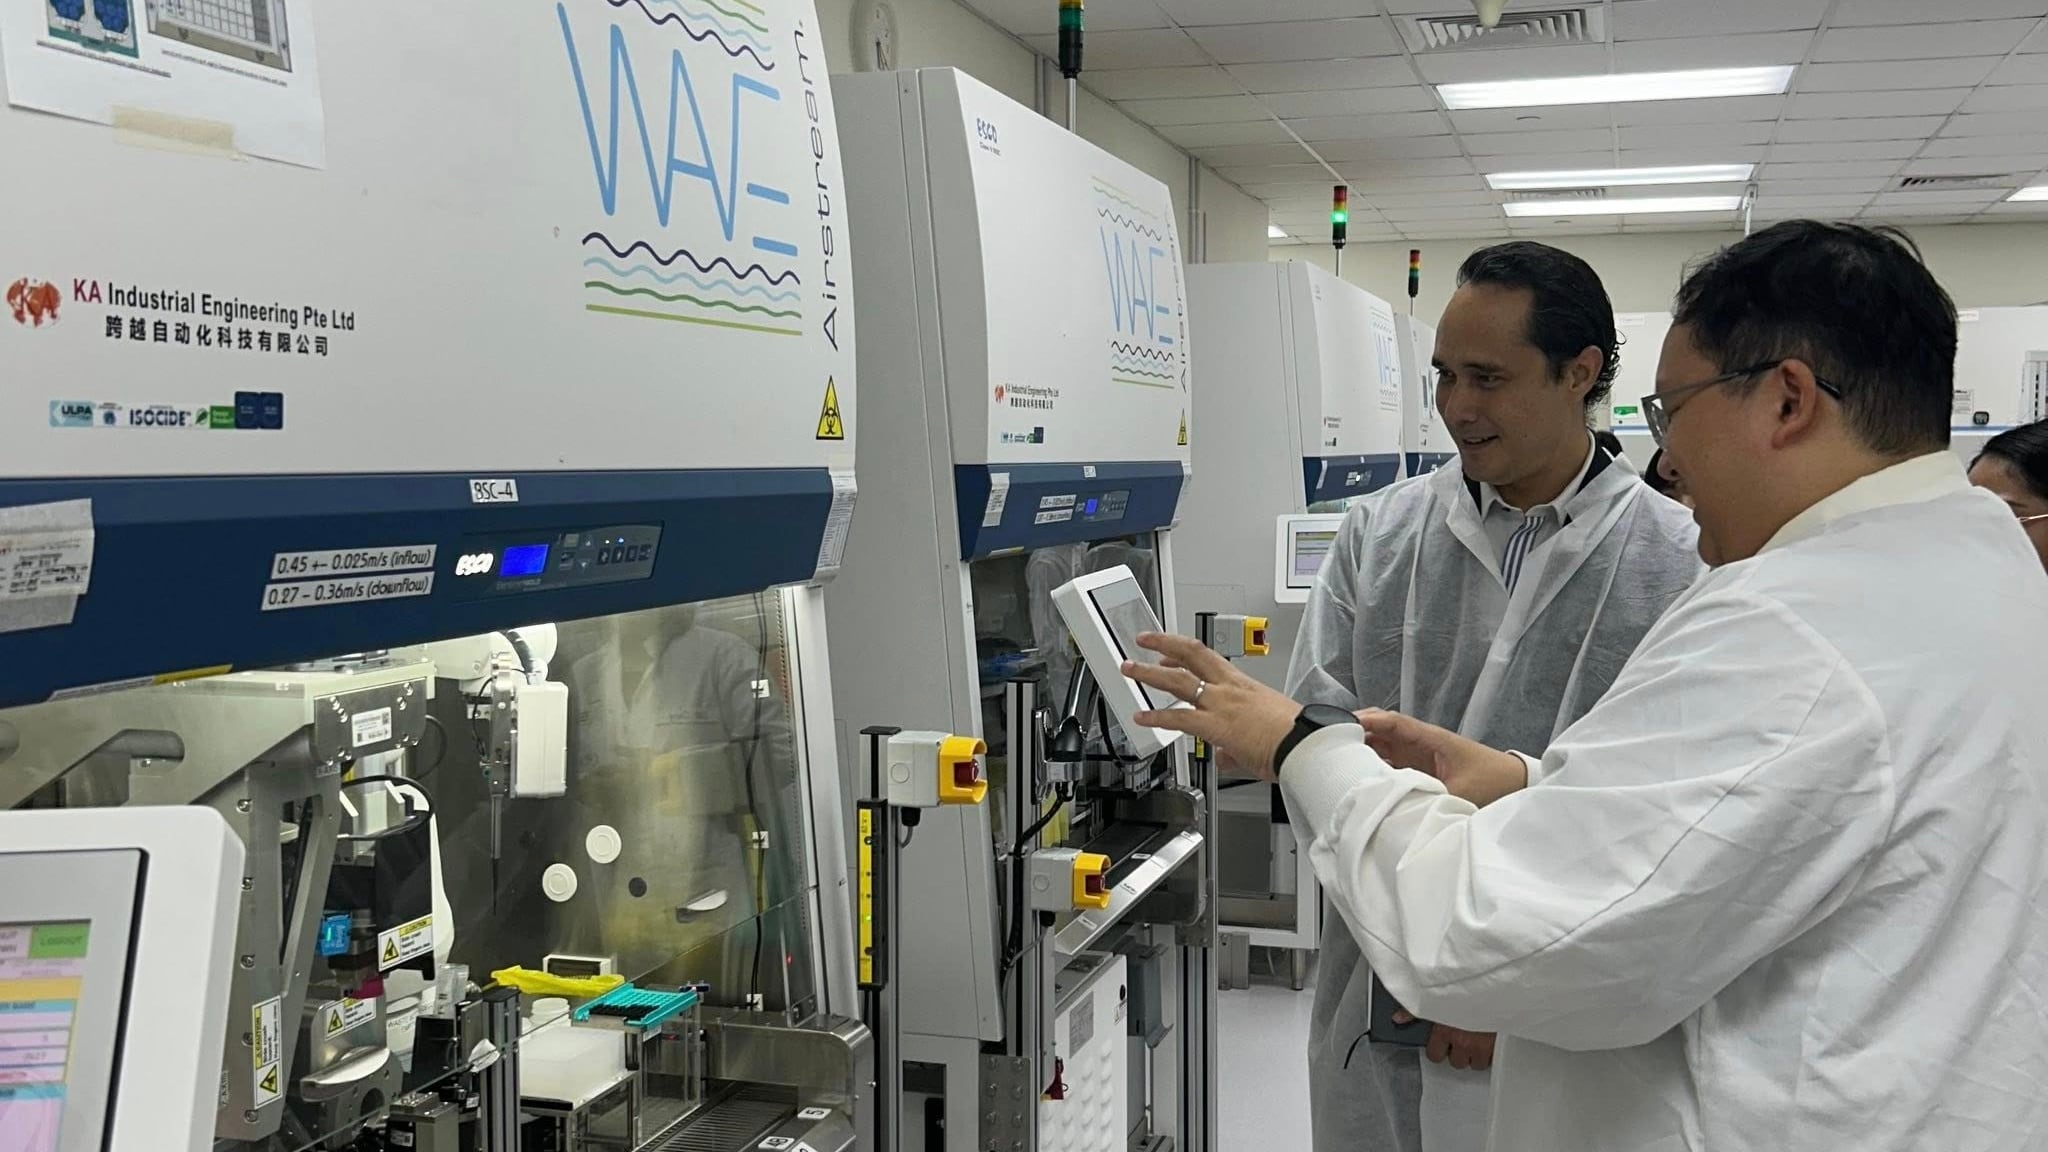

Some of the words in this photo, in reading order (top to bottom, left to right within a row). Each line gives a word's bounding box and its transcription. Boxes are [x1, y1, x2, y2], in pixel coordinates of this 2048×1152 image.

[73, 278, 102, 304] KA
[108, 282, 195, 314] Industrial
[202, 294, 298, 330] Engineering
[303, 305, 328, 328] Pte
[332, 309, 354, 331] Ltd
[105, 314, 328, 357] 跨越自动化科技有限公司
[61, 405, 92, 415] ULPA
[277, 556, 308, 574] 0.45
[332, 552, 388, 570] 0.025m/s
[391, 549, 432, 568] (inflow)
[268, 587, 299, 606] 0.27
[315, 582, 364, 601] 0.36m/s
[367, 576, 429, 599] (downflow)
